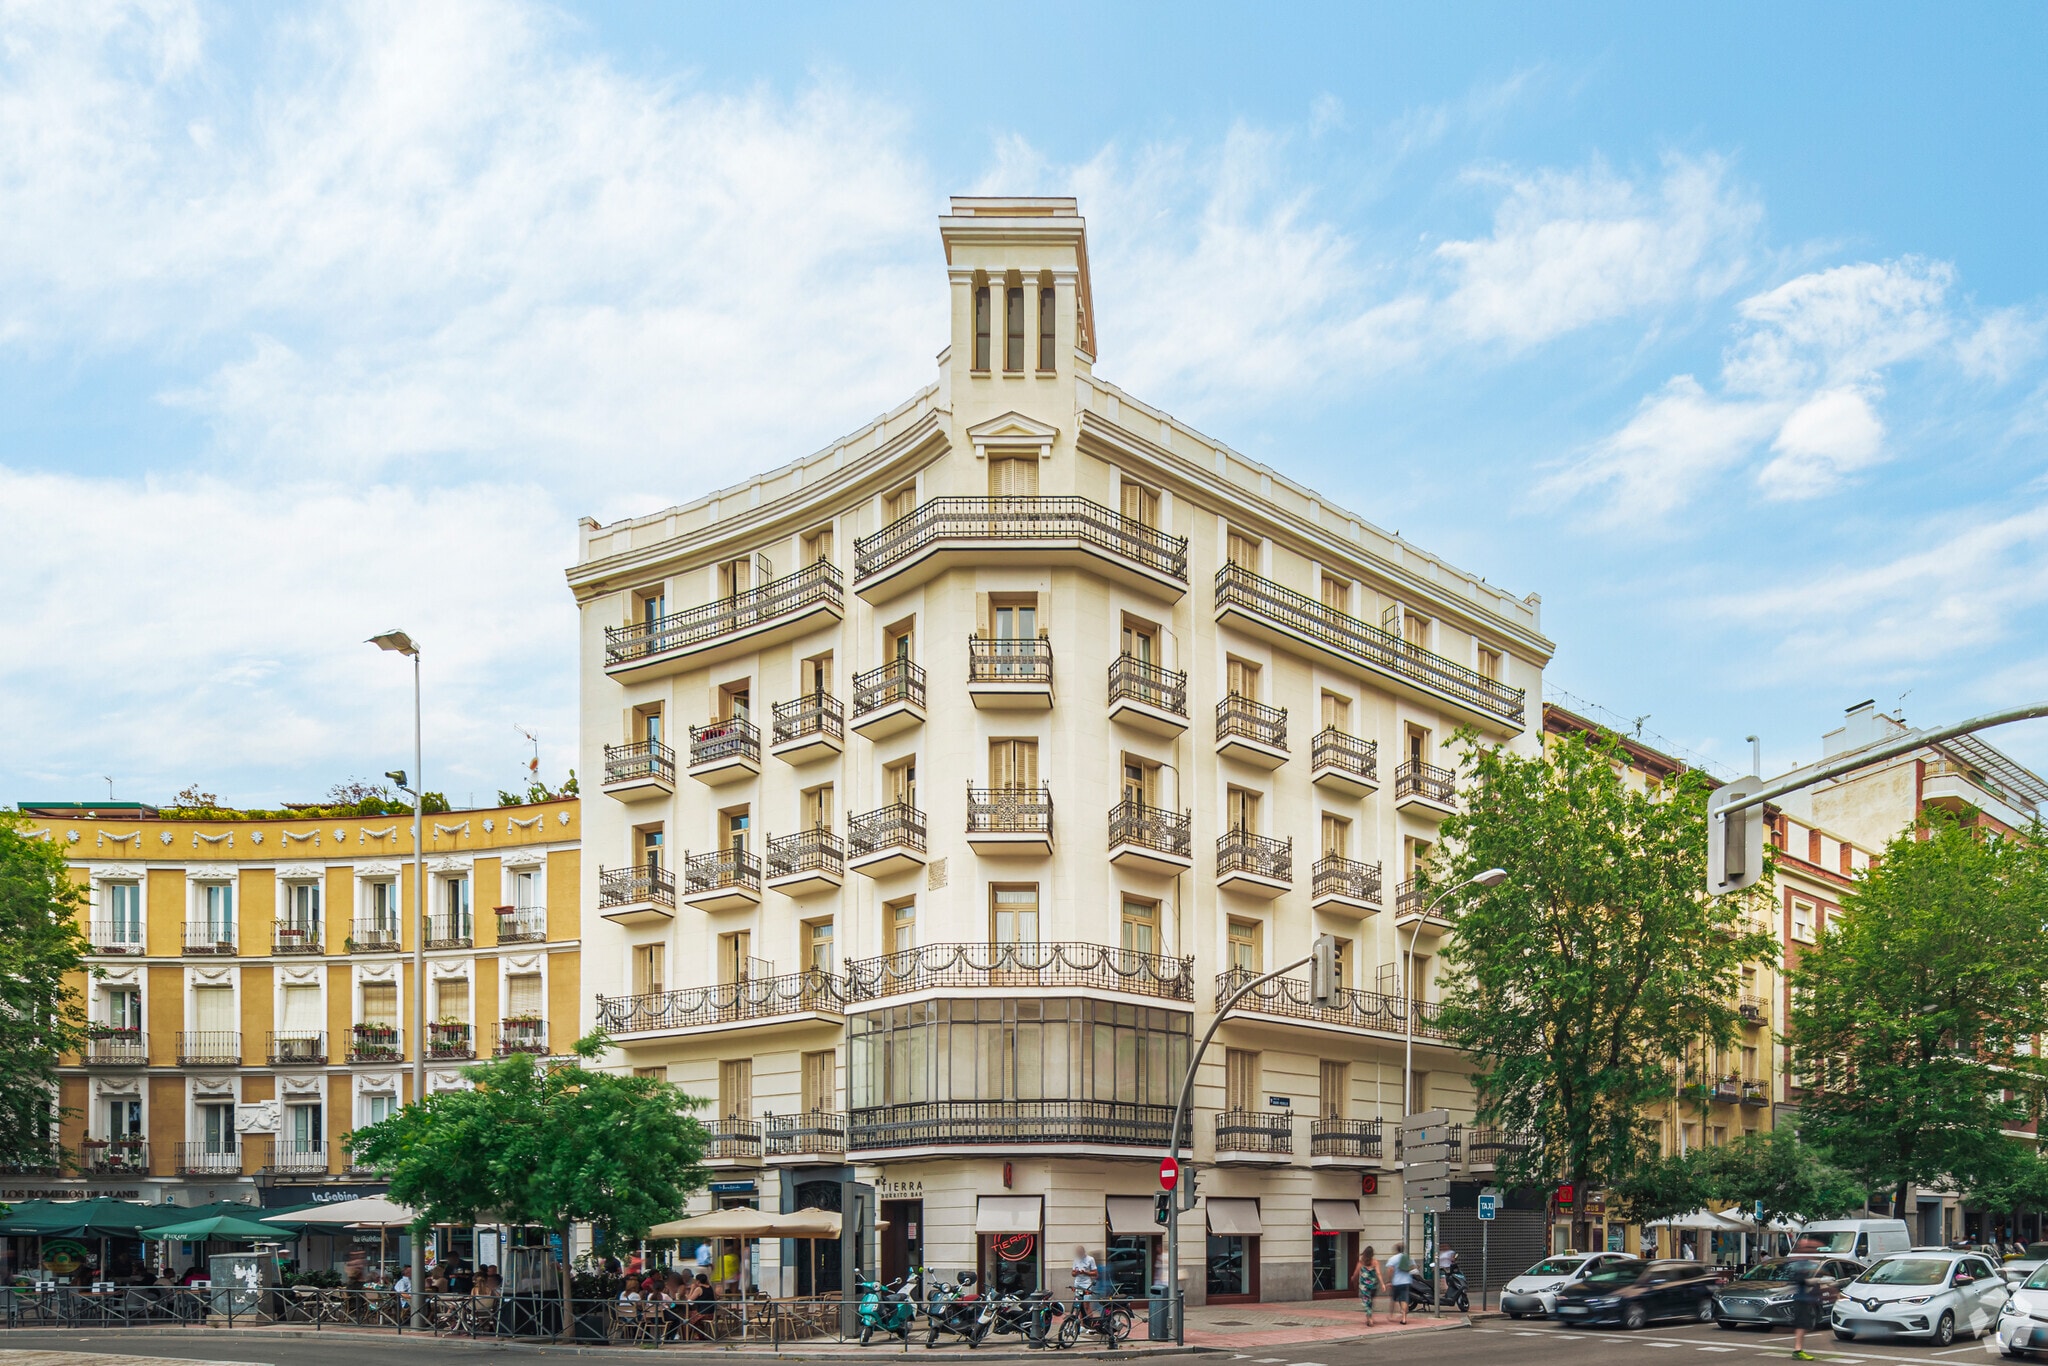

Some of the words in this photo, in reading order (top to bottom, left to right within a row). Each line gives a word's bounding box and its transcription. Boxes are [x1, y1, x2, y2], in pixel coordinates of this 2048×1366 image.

[881, 1181, 923, 1192] TIERRA
[1, 1189, 25, 1199] LOS
[27, 1189, 85, 1199] ROMEROS
[86, 1190, 100, 1199] DE
[209, 1190, 215, 1198] 5
[1480, 1202, 1494, 1210] TAXI
